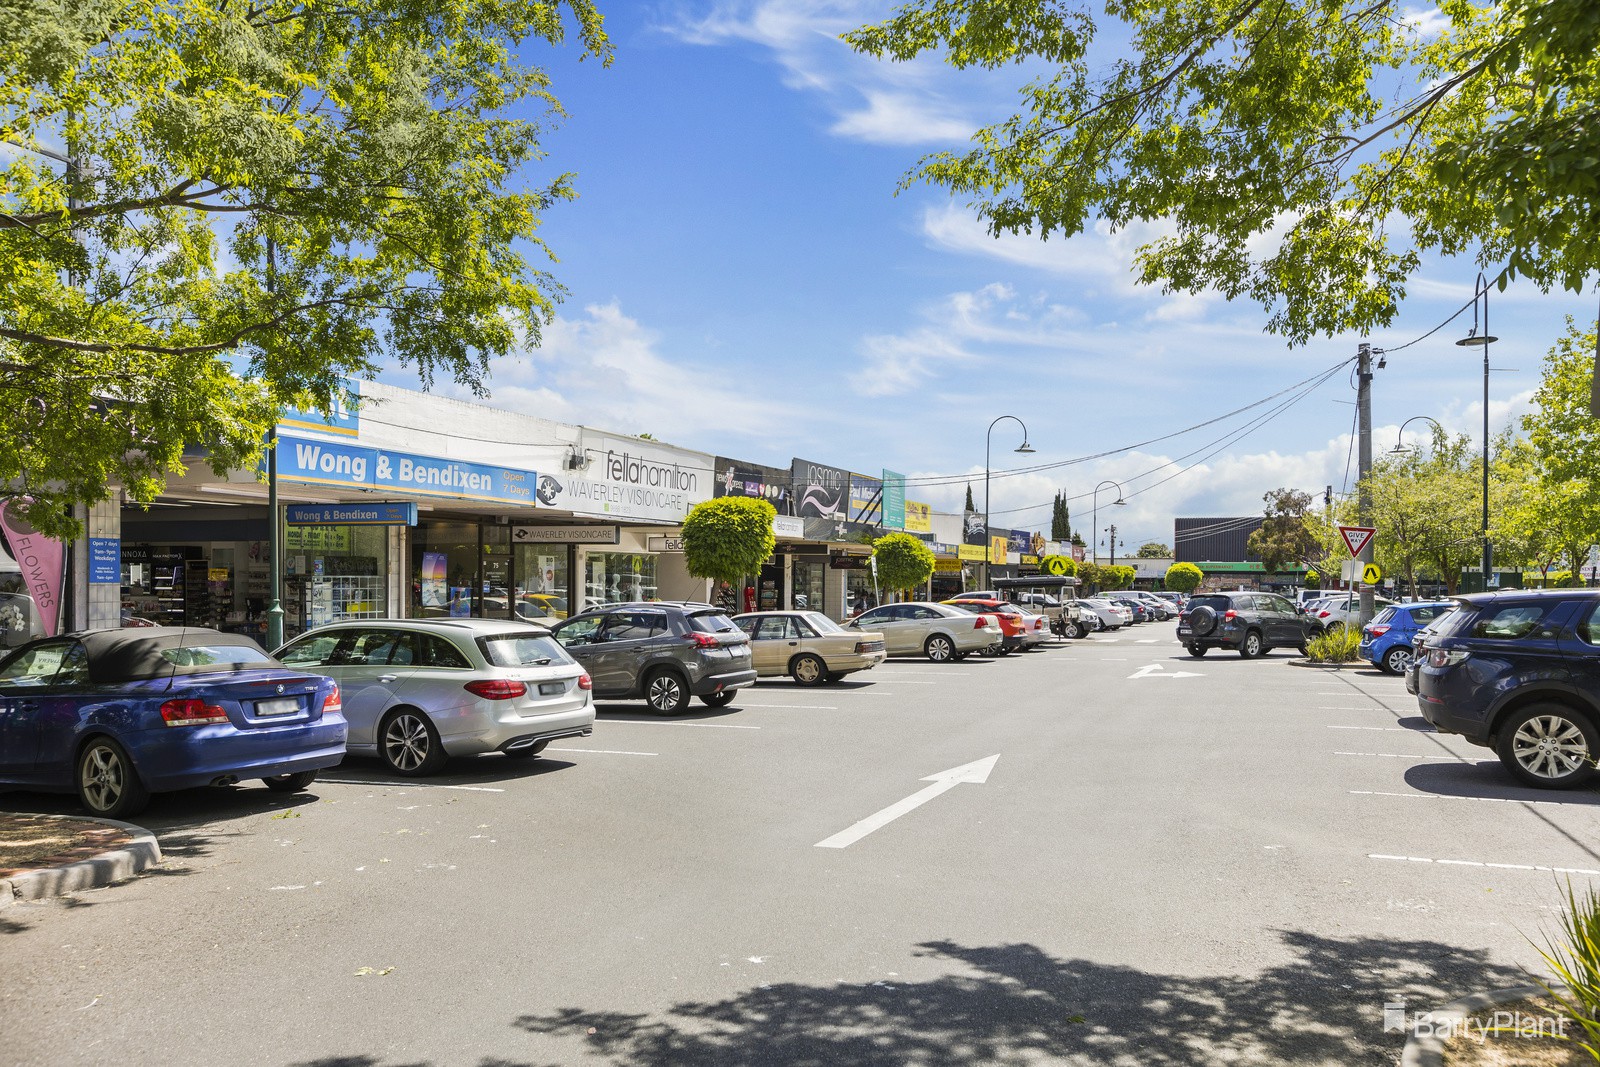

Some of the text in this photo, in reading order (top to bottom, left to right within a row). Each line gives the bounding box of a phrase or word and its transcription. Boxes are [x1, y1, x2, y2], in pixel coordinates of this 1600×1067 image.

[295, 443, 492, 491] Wong & Bendixen
[606, 449, 698, 493] fellahamilton
[503, 470, 525, 482] Open
[503, 483, 530, 496] 7 Days
[567, 479, 626, 504] WAVERLEY
[627, 488, 683, 511] VISIONCARE
[294, 510, 378, 522] Wong & Bendixen
[529, 529, 612, 539] WAVERLEY VISIONCARE
[121, 550, 147, 558] NNOXA
[16, 537, 54, 609] FLOWERS
